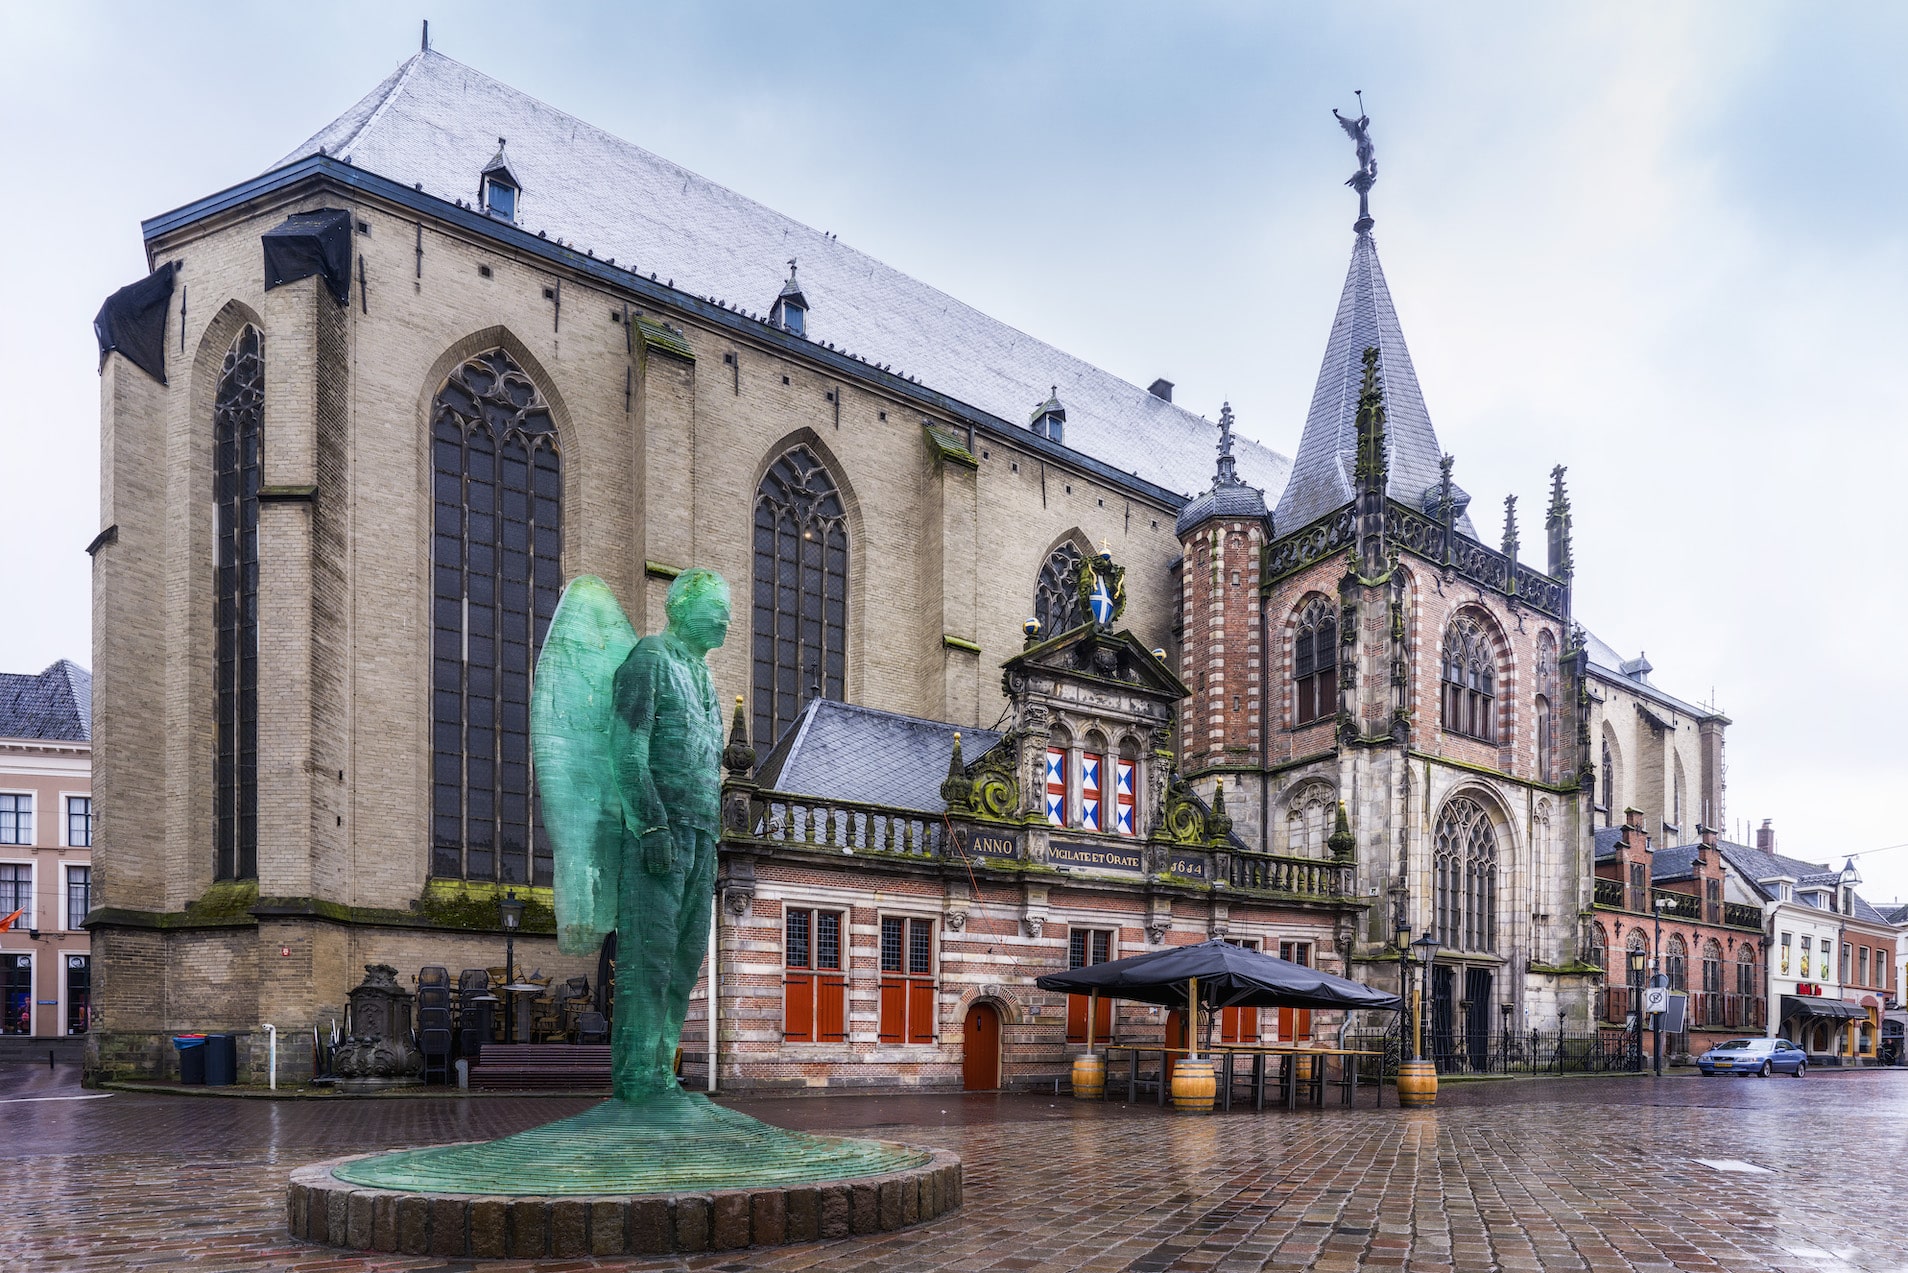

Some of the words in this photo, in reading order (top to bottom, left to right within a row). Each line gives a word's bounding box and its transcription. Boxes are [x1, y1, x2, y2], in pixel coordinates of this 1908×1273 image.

[973, 837, 1013, 855] ANNO
[1048, 847, 1091, 862] VIGILATE
[1092, 853, 1105, 864] ET
[1106, 853, 1139, 867] ORATE
